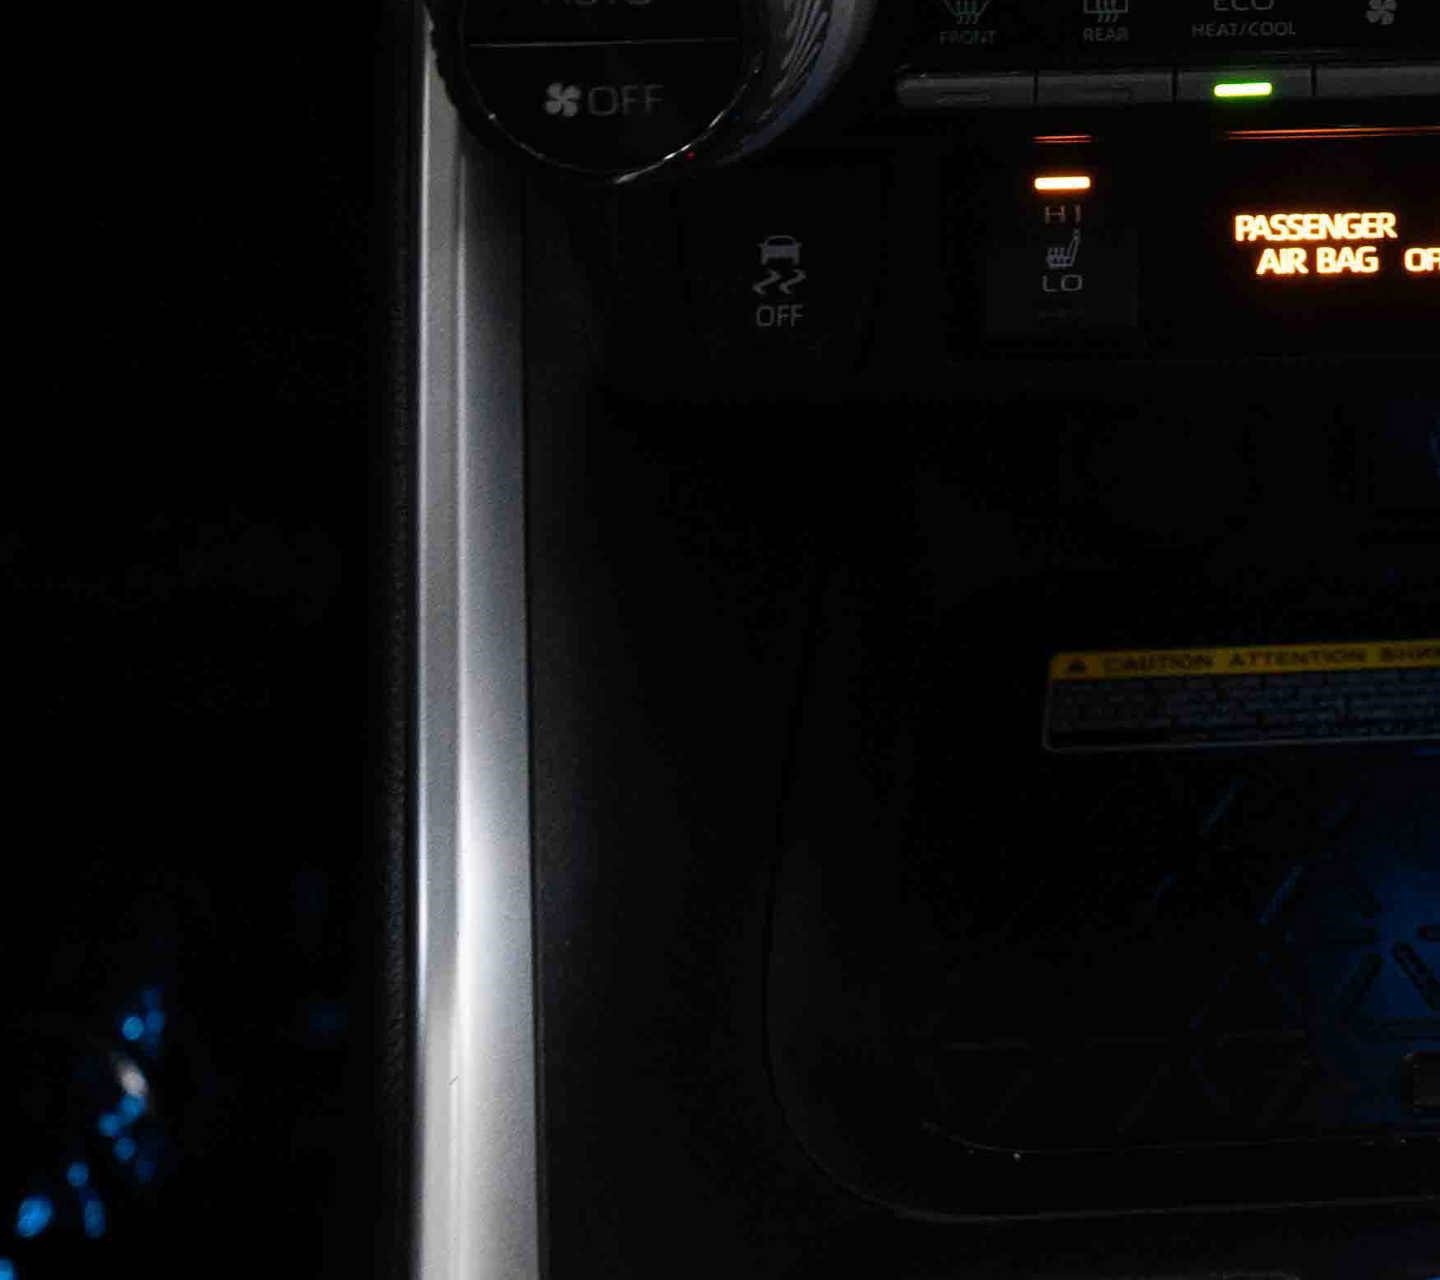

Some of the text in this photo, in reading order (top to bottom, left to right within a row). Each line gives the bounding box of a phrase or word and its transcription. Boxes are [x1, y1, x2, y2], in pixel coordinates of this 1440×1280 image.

[1082, 26, 1130, 43] REAR
[587, 83, 664, 117] OFF
[1042, 203, 1082, 224] HI
[1234, 211, 1398, 244] PASSENGER
[1255, 246, 1310, 276] AIR
[1315, 245, 1380, 275] BAG
[1042, 273, 1083, 293] LO
[755, 304, 804, 327] OFF
[1102, 652, 1216, 673] CAUTION
